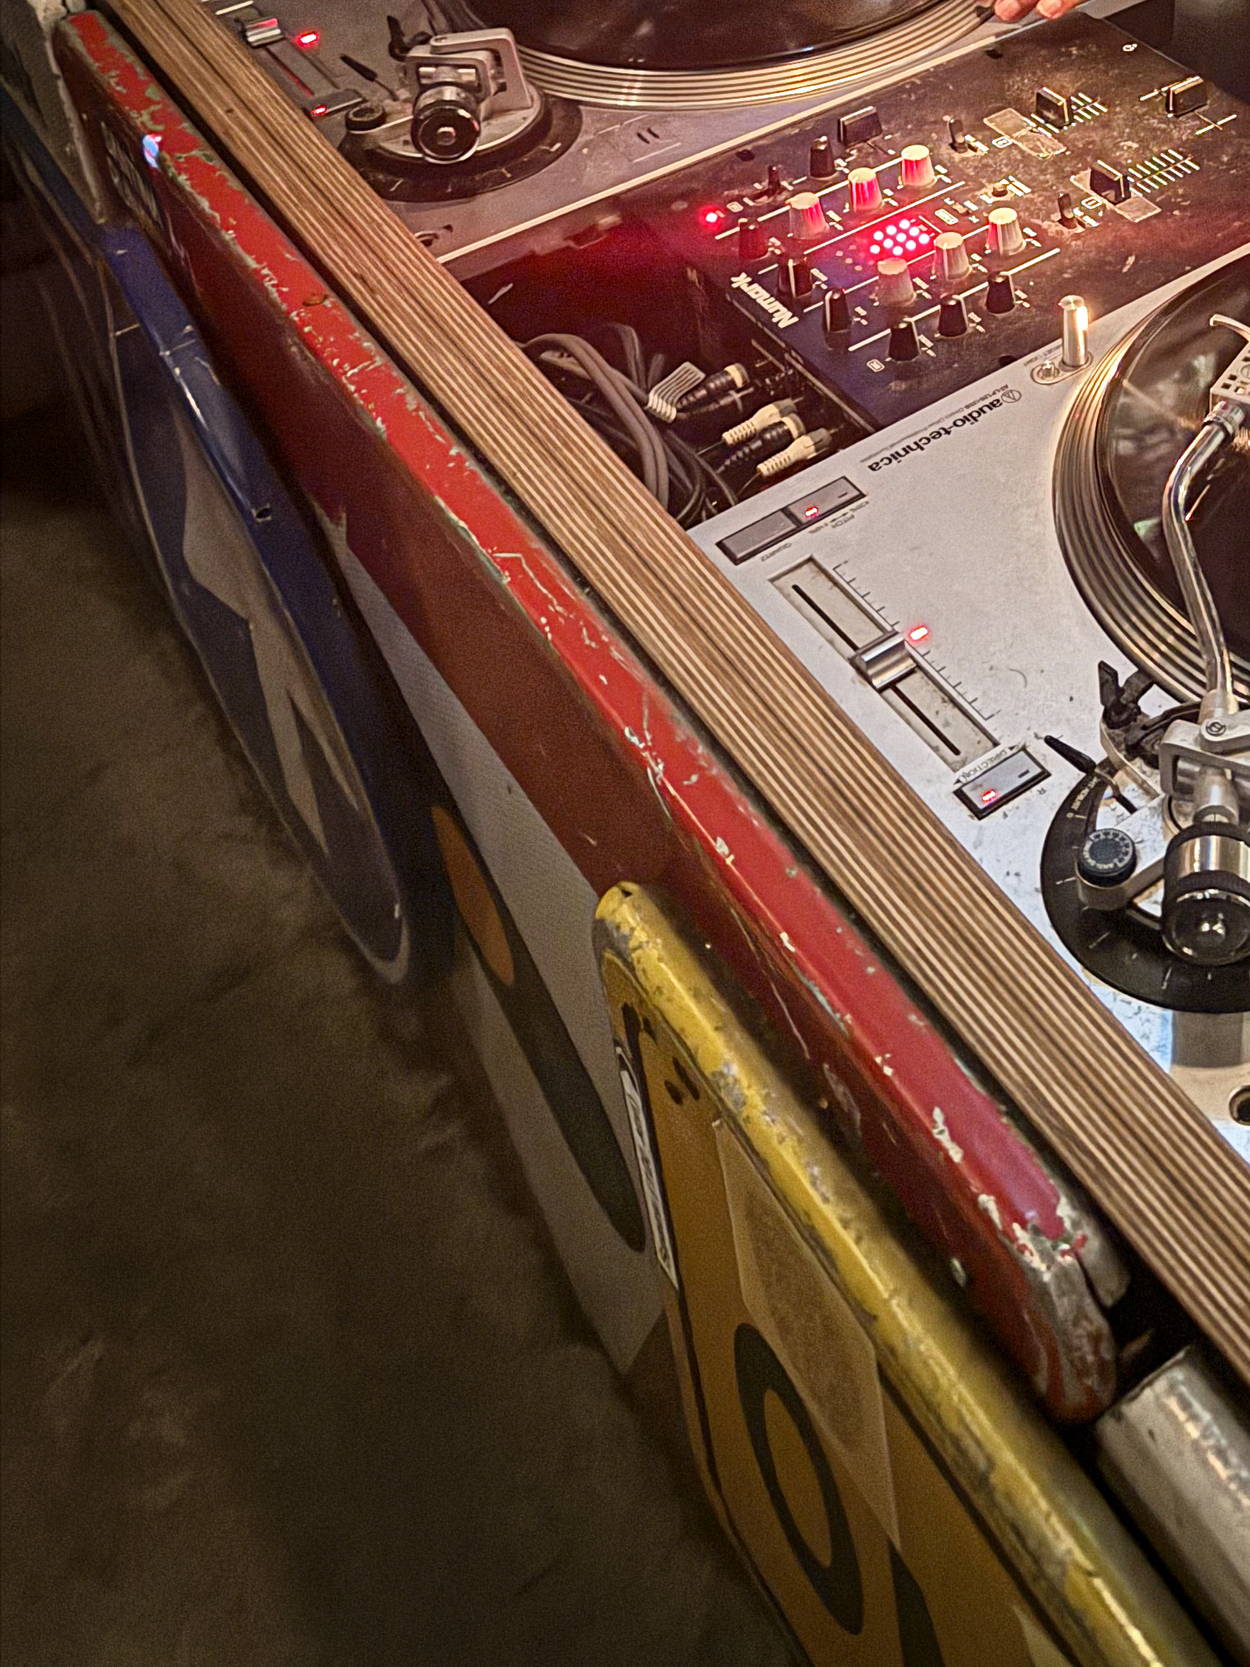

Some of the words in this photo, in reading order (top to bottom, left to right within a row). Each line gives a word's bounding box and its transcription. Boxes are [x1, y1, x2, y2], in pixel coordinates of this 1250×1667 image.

[730, 271, 800, 329] Numark
[867, 397, 1004, 473] audio-technica
[962, 749, 1008, 783] DIRECTION
